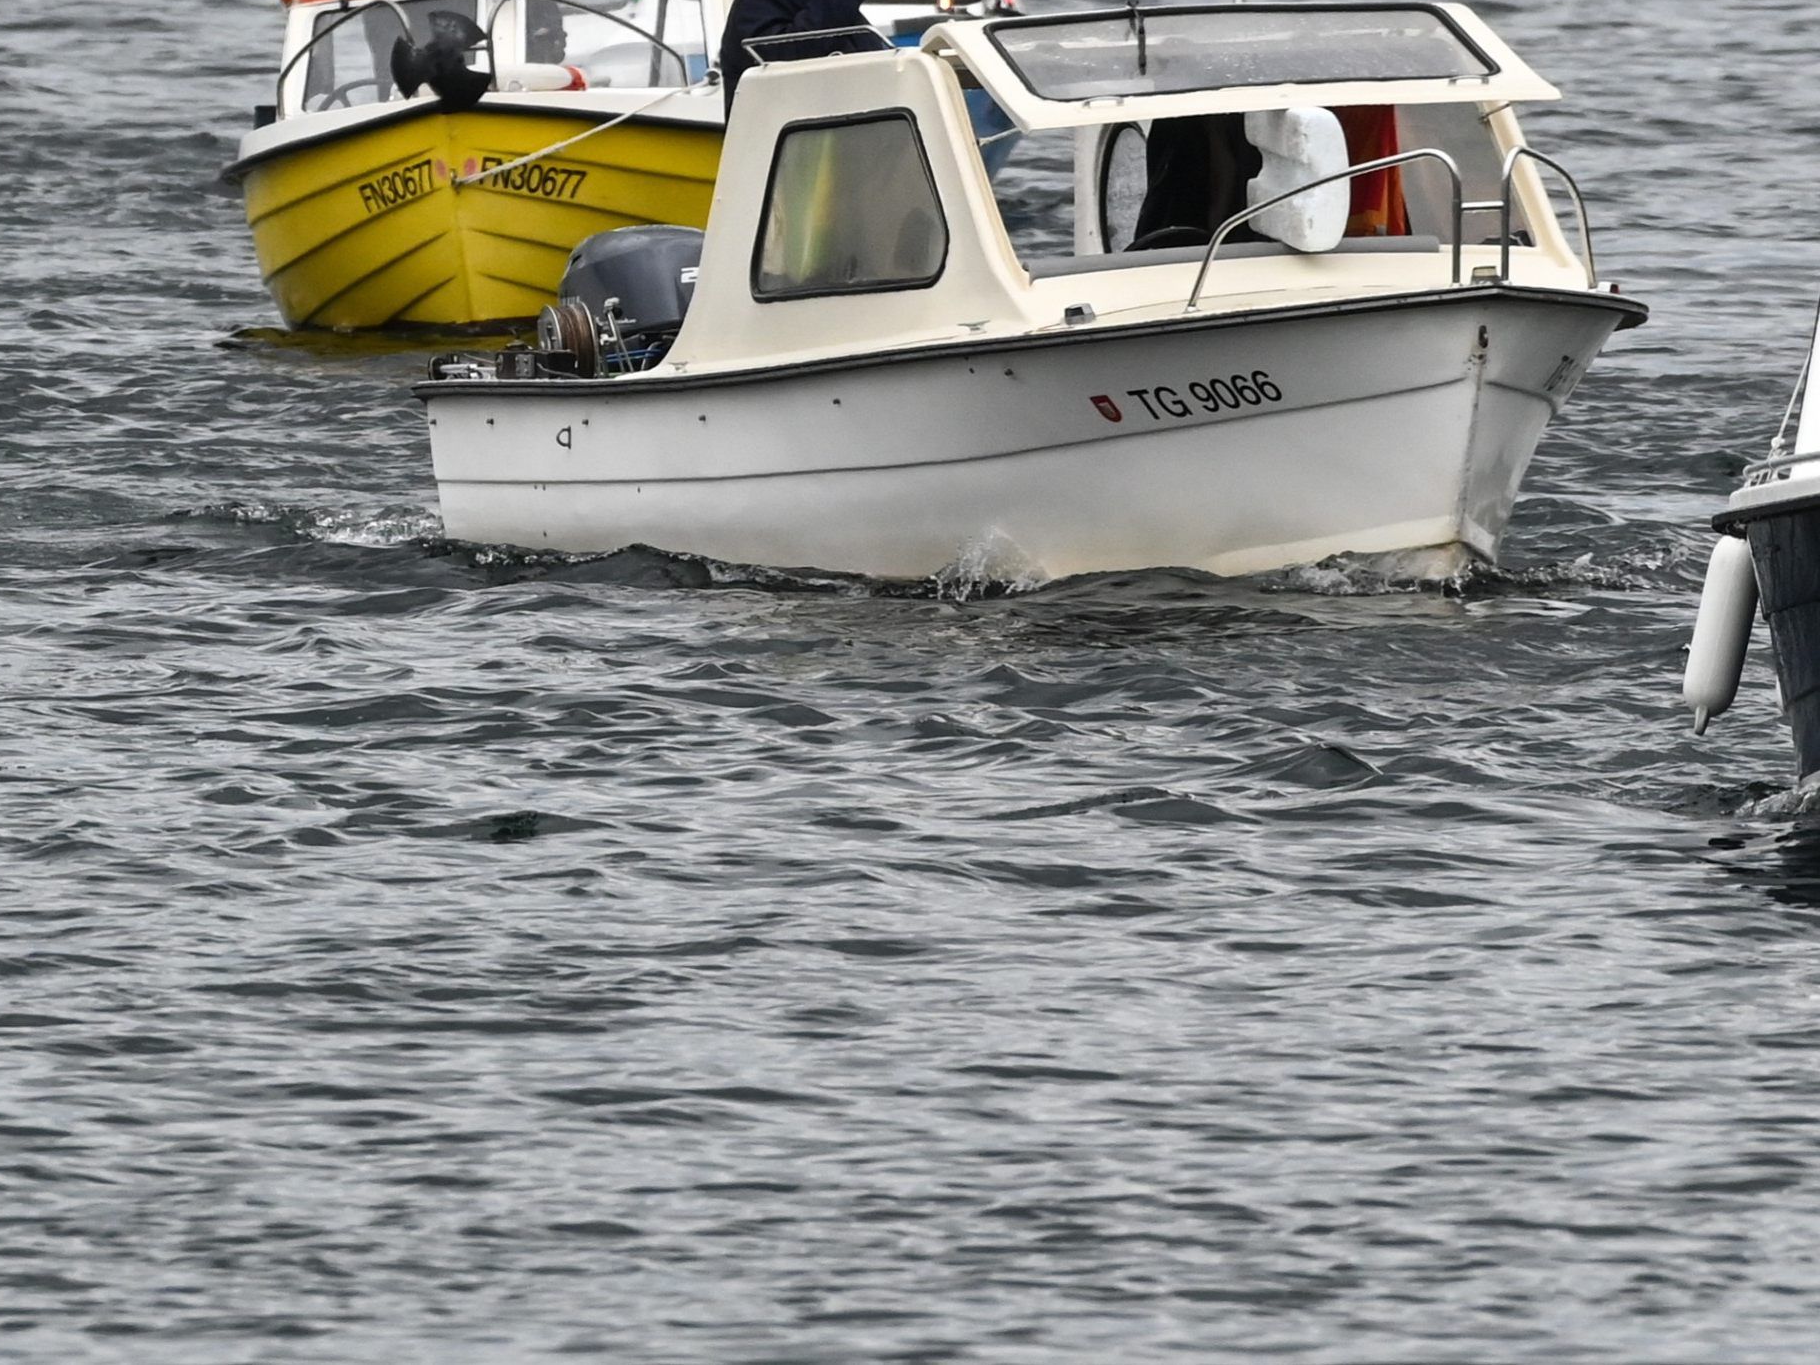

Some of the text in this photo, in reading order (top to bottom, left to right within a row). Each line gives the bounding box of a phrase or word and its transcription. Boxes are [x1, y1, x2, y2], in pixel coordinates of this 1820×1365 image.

[358, 159, 435, 213] FN30677
[480, 156, 587, 200] FN30677
[1127, 370, 1282, 420] TG 9066
